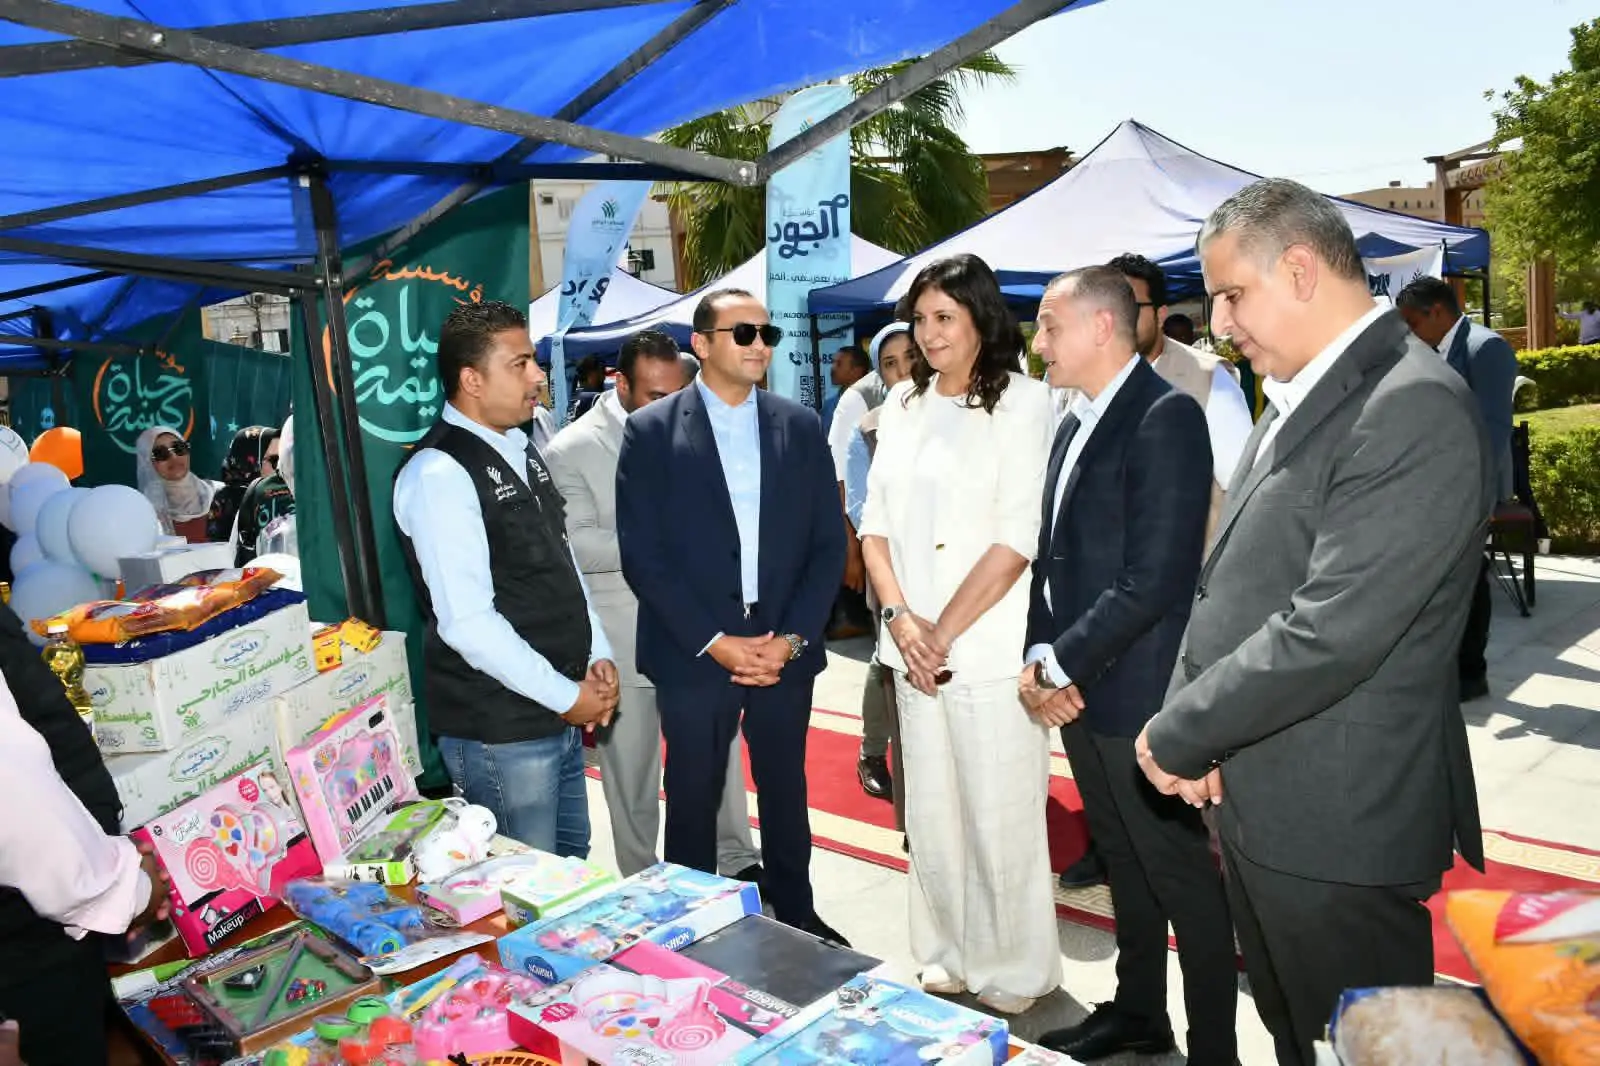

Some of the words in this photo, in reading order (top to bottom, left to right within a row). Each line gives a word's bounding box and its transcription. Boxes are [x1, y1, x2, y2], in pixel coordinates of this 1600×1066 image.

[767, 193, 850, 259] الجود
[369, 258, 486, 305] ؤسسة
[348, 284, 440, 369] ياة
[107, 356, 191, 408] حياة
[351, 357, 447, 417] يمة
[248, 643, 305, 678] مؤسسة
[207, 914, 244, 944] Makeup
